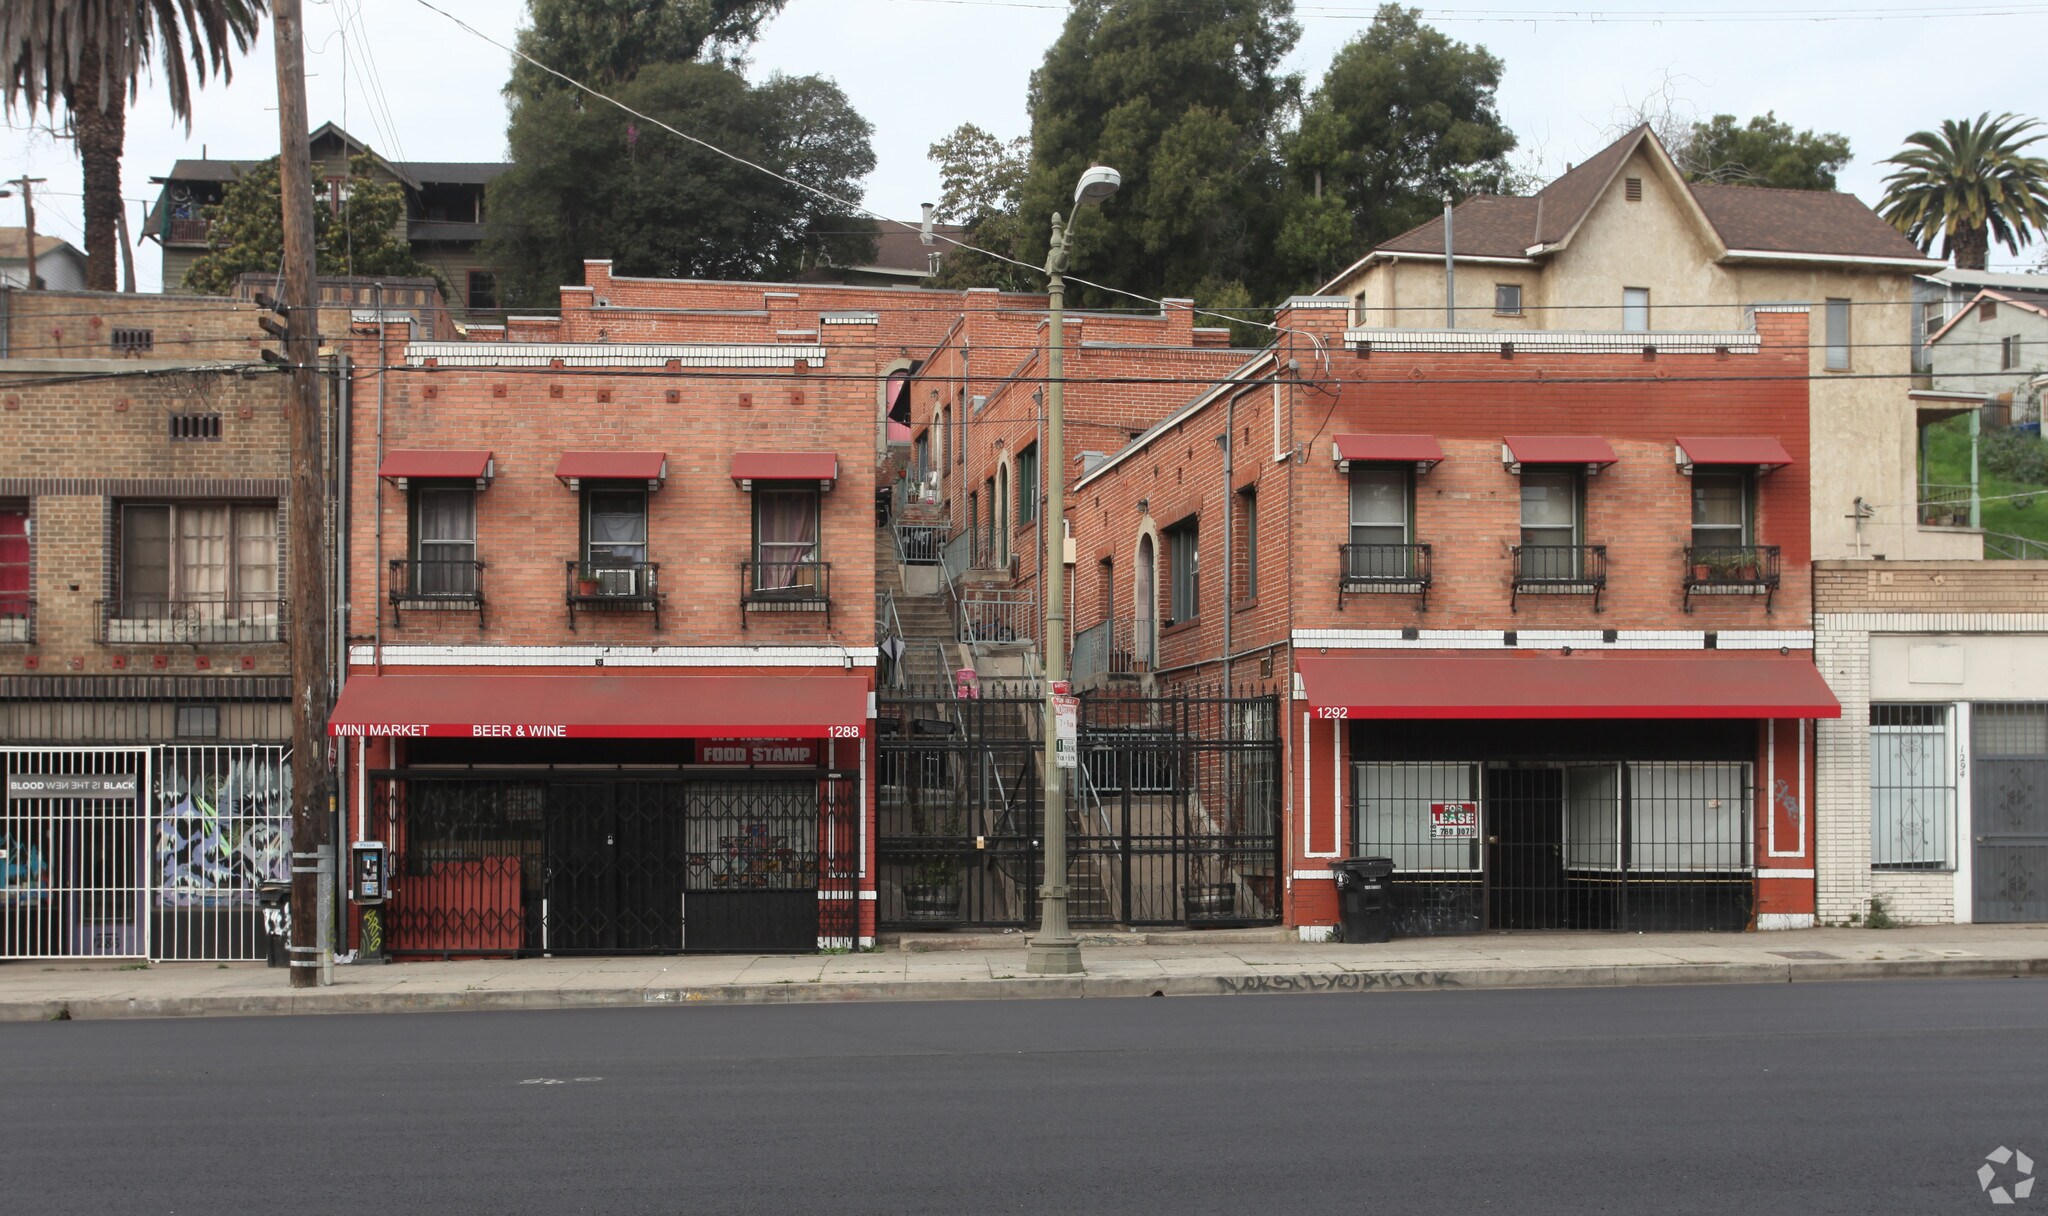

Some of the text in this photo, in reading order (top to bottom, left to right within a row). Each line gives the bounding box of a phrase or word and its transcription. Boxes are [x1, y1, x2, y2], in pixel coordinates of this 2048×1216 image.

[1317, 706, 1348, 719] 1292
[335, 724, 430, 736] MINI MARKET
[472, 725, 567, 737] BEER & WINE
[828, 726, 859, 738] 1288
[703, 747, 811, 762] FOOD STAMP
[10, 781, 45, 790] BLOOD
[103, 781, 135, 790] BLACK
[1444, 804, 1463, 812] FOR
[1432, 812, 1475, 824] LEASE
